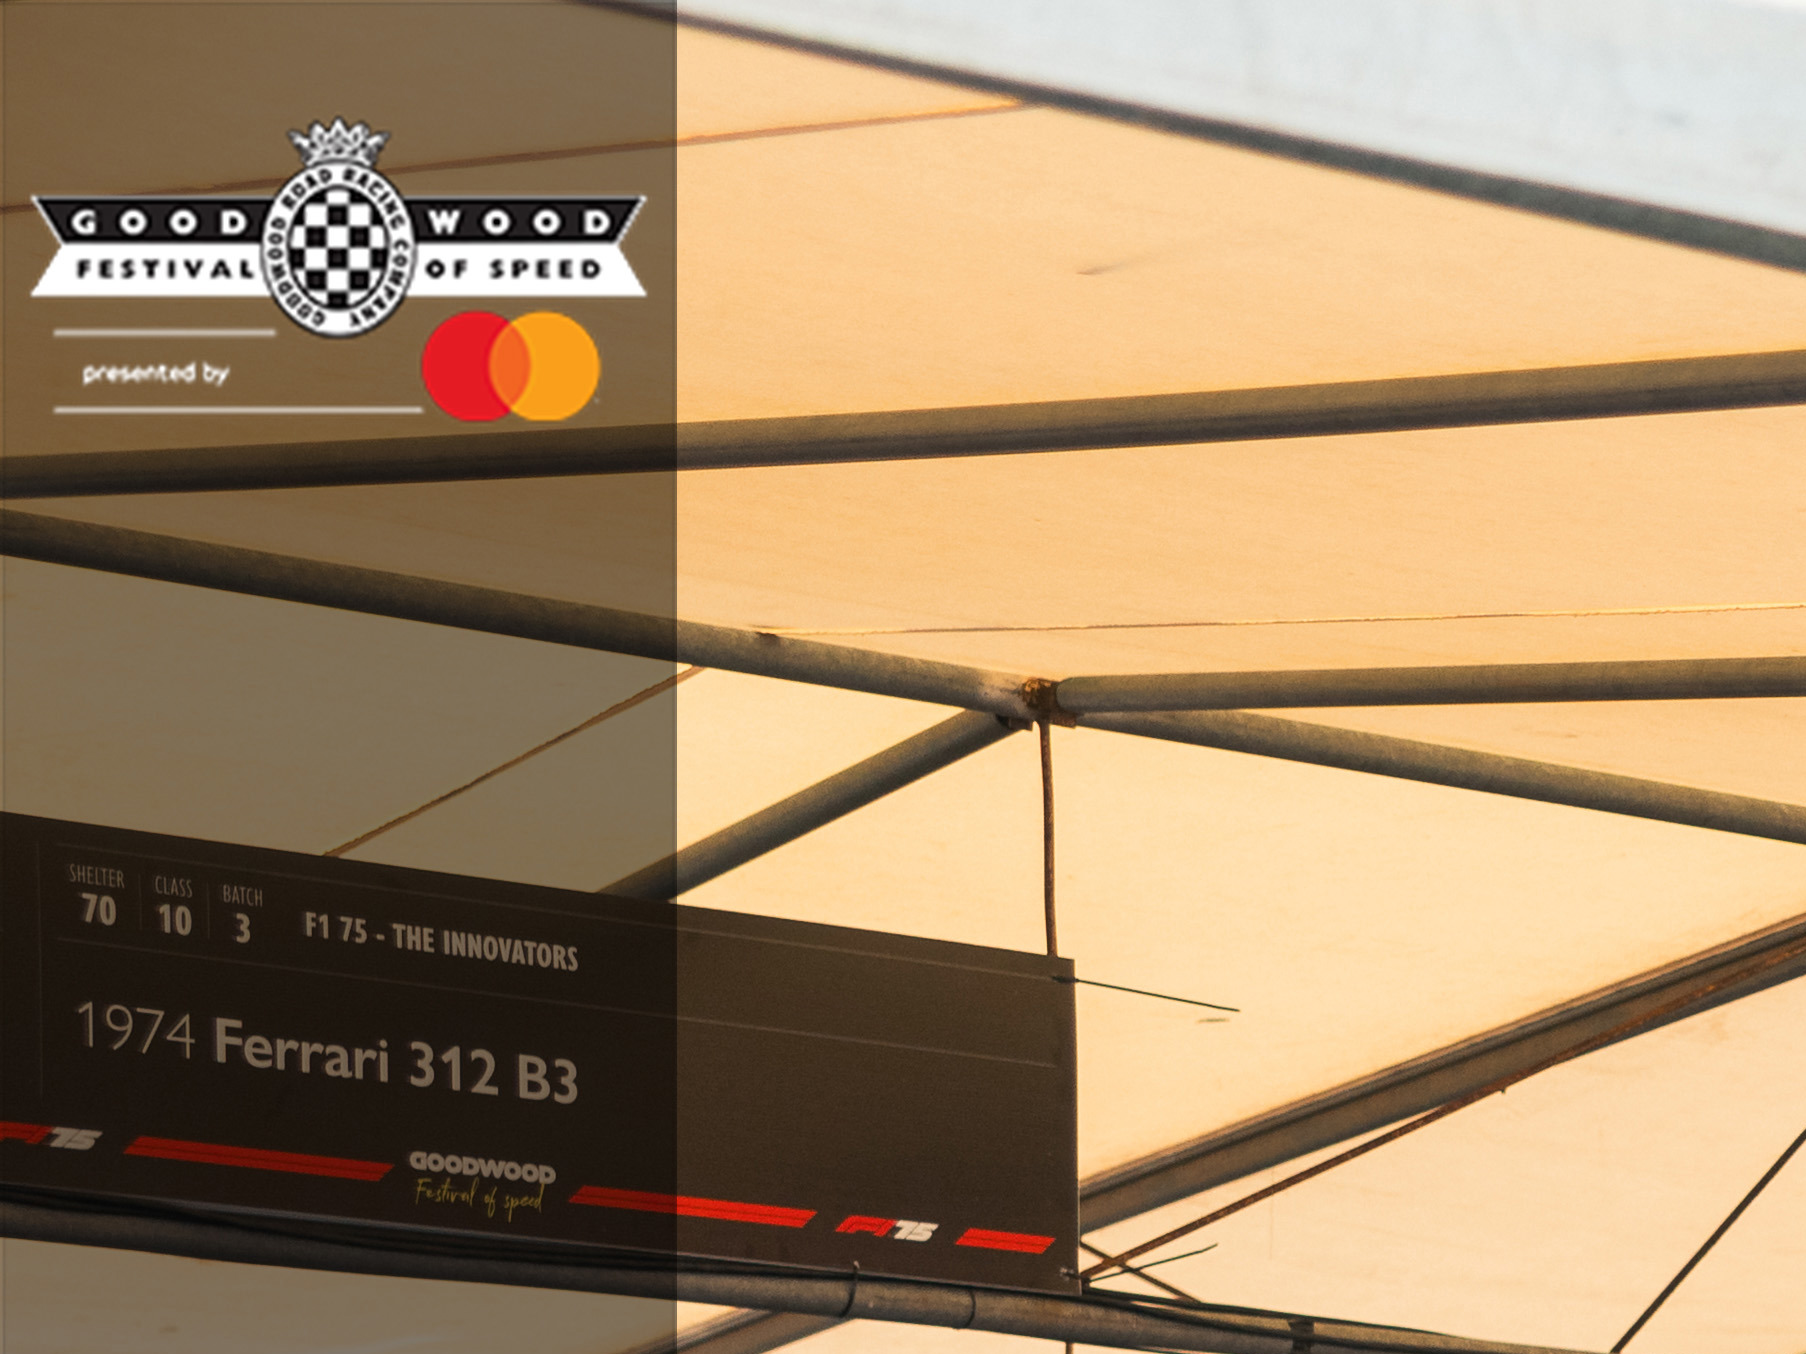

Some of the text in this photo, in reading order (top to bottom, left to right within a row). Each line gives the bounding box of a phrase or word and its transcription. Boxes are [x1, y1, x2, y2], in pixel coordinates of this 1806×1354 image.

[69, 862, 263, 908] SHELTER CLASS BATCH
[82, 892, 117, 927] 70
[159, 903, 192, 937] 10
[236, 913, 251, 944] 3
[305, 911, 330, 939] F1
[340, 915, 368, 945] 75
[392, 922, 435, 954] THE
[443, 928, 579, 973] INNOVATORS
[75, 1000, 578, 1105] 1974 Ferrari 312 B3
[410, 1151, 557, 1186] GOODWOOD
